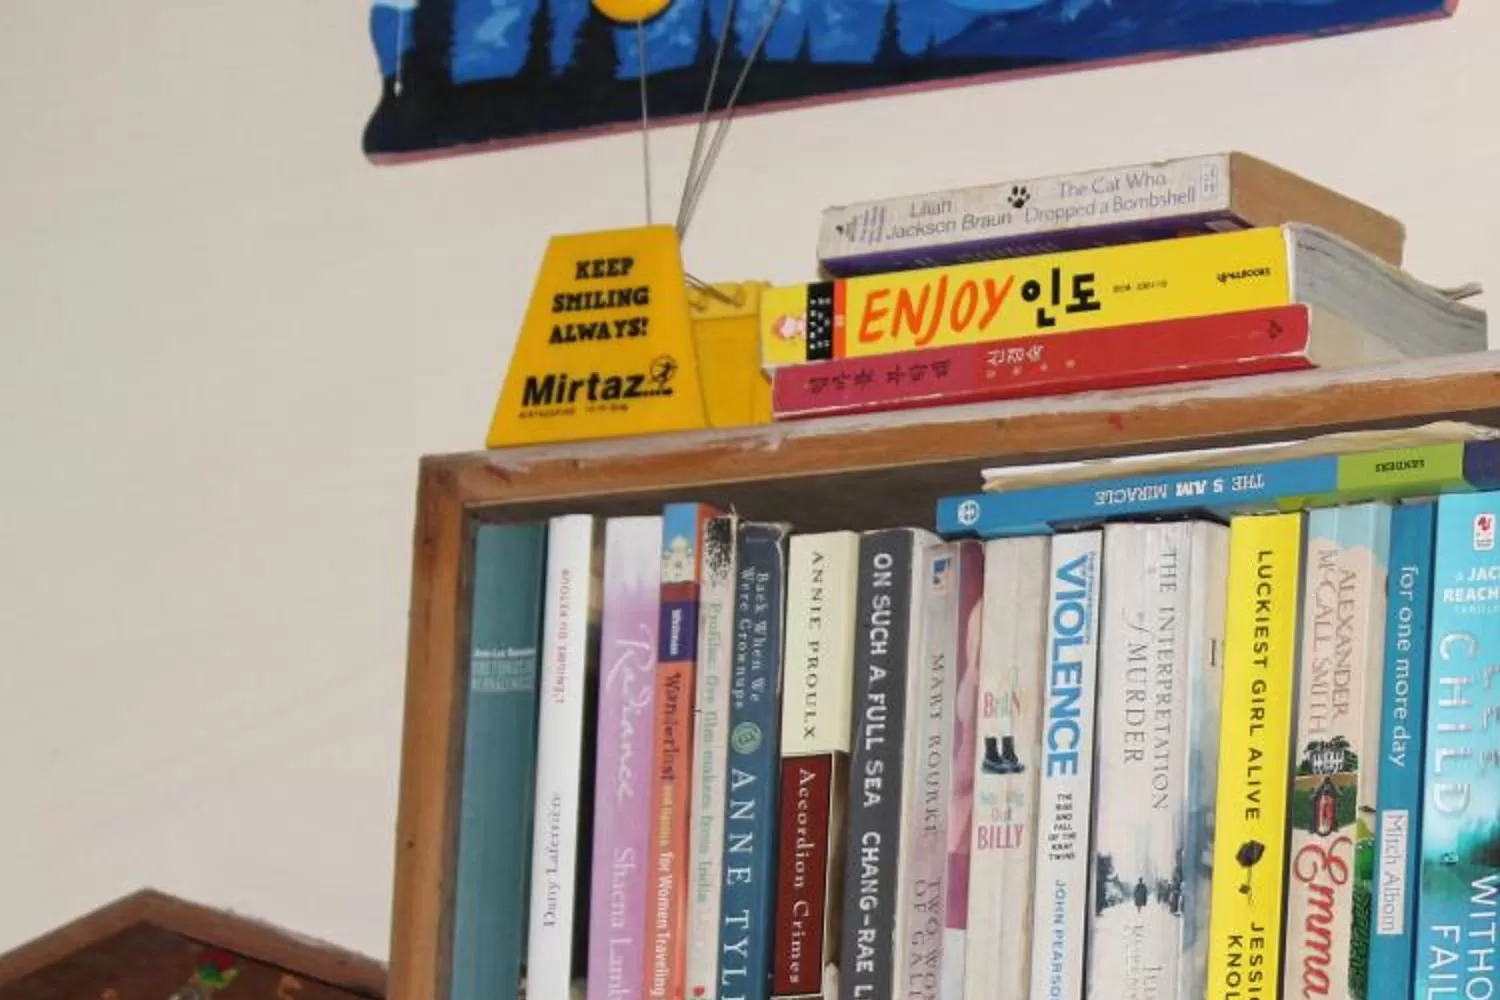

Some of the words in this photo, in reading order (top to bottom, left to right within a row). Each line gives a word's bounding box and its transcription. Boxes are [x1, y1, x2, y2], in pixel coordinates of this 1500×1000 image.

[1059, 181, 1089, 198] The
[1092, 175, 1120, 194] Cat
[1127, 170, 1166, 189] Who
[886, 219, 958, 240] Jackson
[962, 211, 1012, 230] Braun
[575, 256, 635, 280] KEEP
[551, 286, 650, 314] SMILING
[858, 274, 1015, 346] ENJOY
[1021, 267, 1101, 328] 인도
[548, 317, 649, 346] ALWAYS!
[521, 371, 643, 409] Mirtaz
[808, 551, 825, 632] ANNIE
[872, 553, 893, 588] ON
[1159, 550, 1178, 593] THE
[1399, 565, 1419, 588] for
[869, 595, 892, 655] SUCH
[1251, 550, 1273, 669] LUCKIEST
[1396, 609, 1412, 652] one
[802, 640, 820, 739] PROULX
[869, 665, 885, 682] A
[1047, 553, 1089, 778] VIOLENCE
[1394, 659, 1410, 714] more
[865, 694, 887, 751] FULL
[1152, 607, 1175, 810] INTERPRETATION
[1250, 678, 1268, 736] GIRL
[1392, 717, 1411, 767] day
[863, 762, 884, 808] SEA
[1244, 749, 1264, 820] ALIVE
[727, 768, 759, 886] ANNE
[794, 767, 817, 888] Accordion
[977, 824, 1024, 849] BILLY
[1384, 815, 1405, 864] Mitch
[659, 851, 674, 872] for
[656, 875, 674, 929] Women
[856, 832, 880, 973] CHANG-RAE
[1053, 880, 1067, 924] JOHN
[1293, 835, 1353, 1000] Emma
[1380, 870, 1401, 931] Albom
[651, 932, 670, 997] Traveling
[789, 900, 810, 984] Crimes
